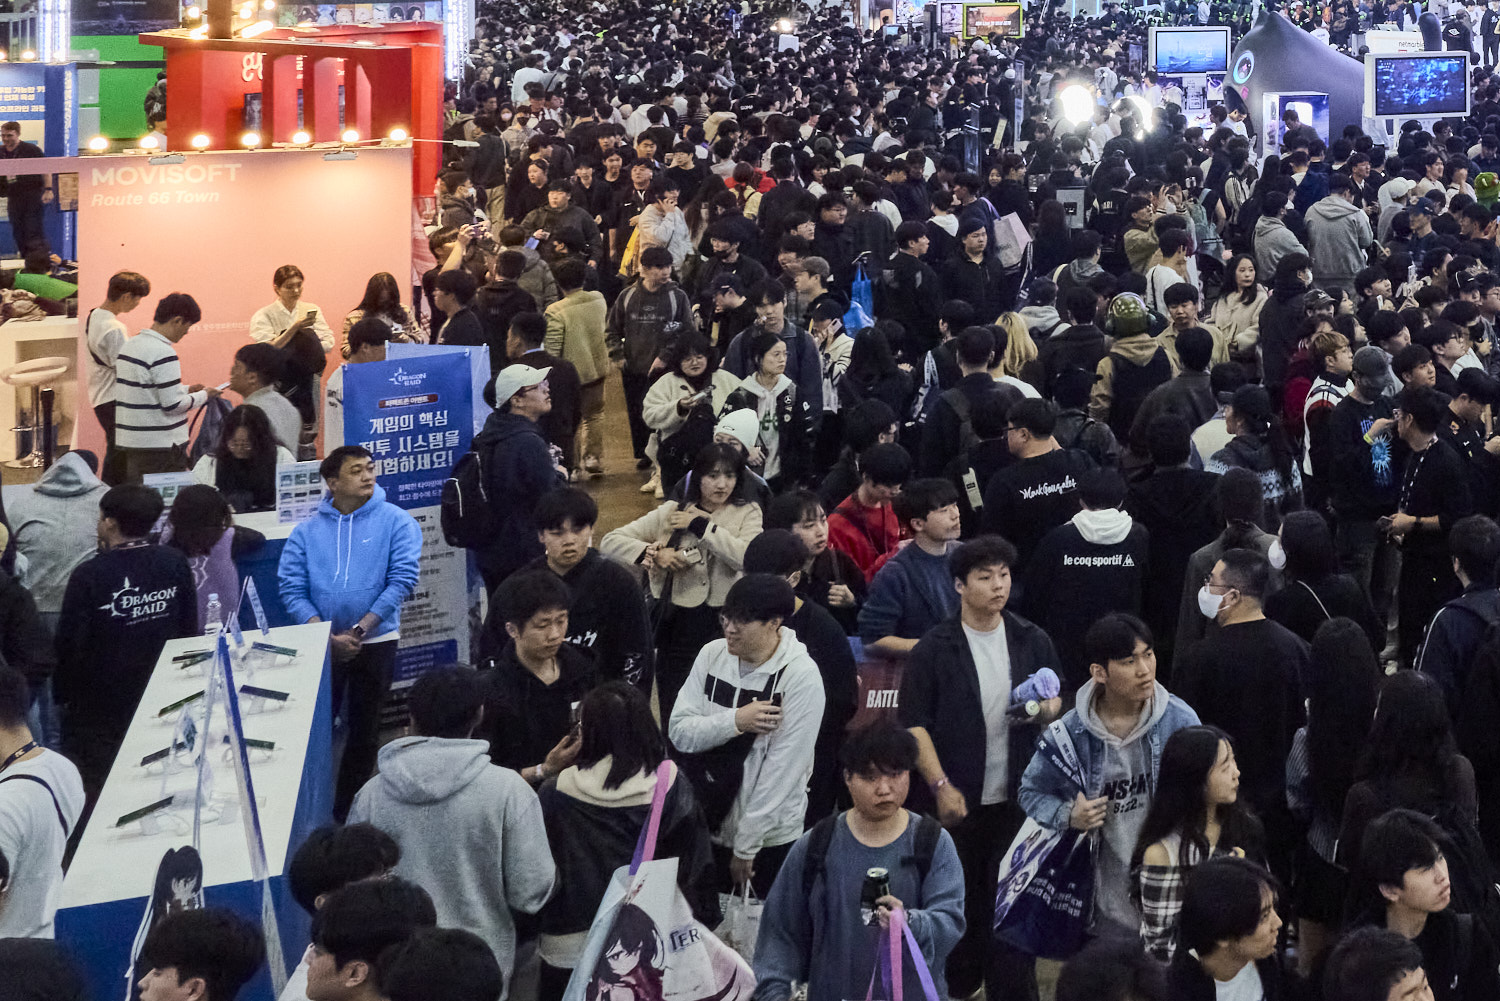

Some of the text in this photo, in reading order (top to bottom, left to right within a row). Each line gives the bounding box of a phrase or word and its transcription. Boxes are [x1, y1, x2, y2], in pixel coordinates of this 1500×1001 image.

[91, 163, 242, 187] MOVISOFT
[91, 190, 220, 207] Route 66 Town
[398, 372, 427, 382] DRAGON
[369, 410, 448, 434] 게임의 핵심
[396, 429, 460, 454] 시스템을
[1063, 554, 1123, 568] le coq sportif
[121, 586, 177, 609] DRAGON
[131, 600, 168, 618] RAID
